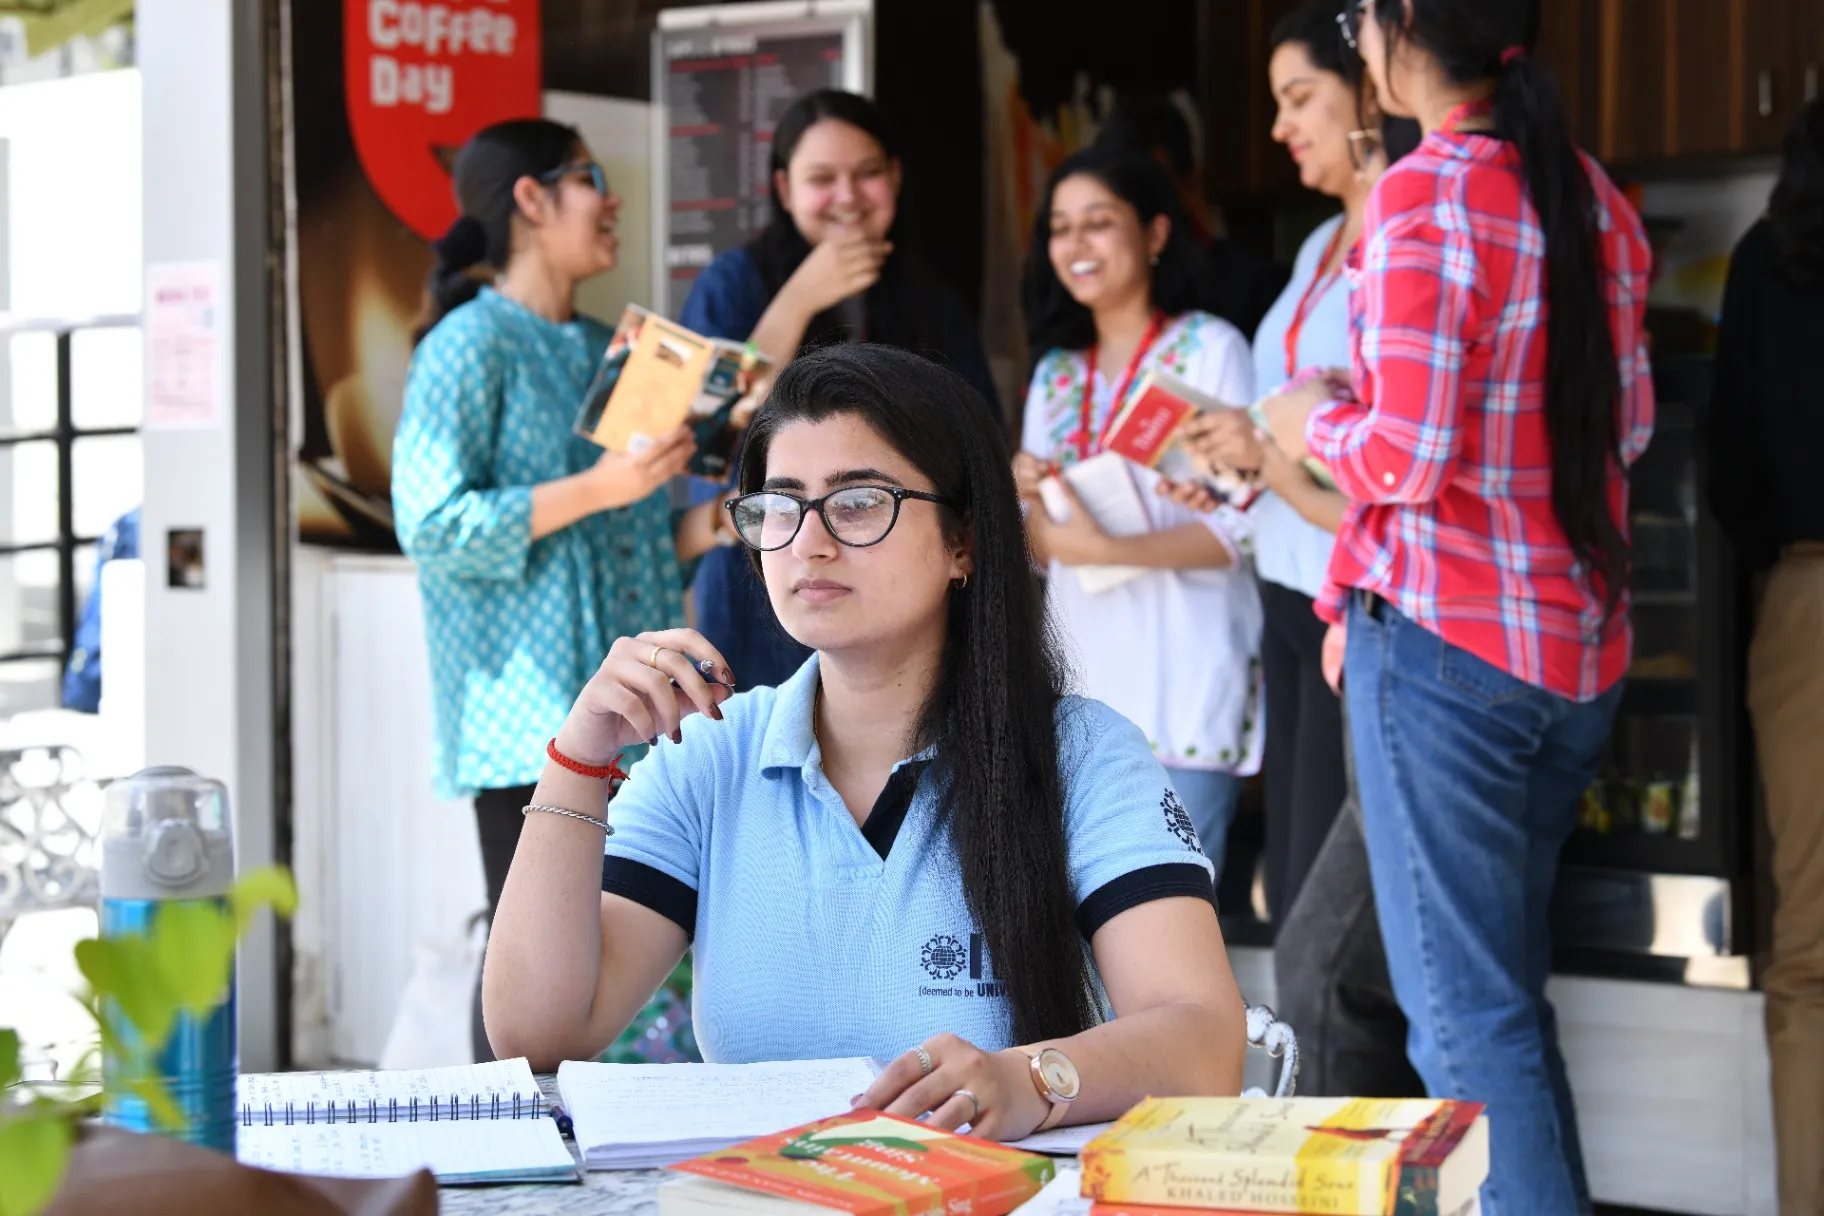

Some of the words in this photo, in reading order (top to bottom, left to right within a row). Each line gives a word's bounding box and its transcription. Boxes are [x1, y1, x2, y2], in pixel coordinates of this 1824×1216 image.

[369, 55, 453, 114] Day
[954, 988, 963, 997] to
[964, 987, 974, 998] be
[1131, 1165, 1151, 1184] A
[1166, 1187, 1245, 1202] KHALED
